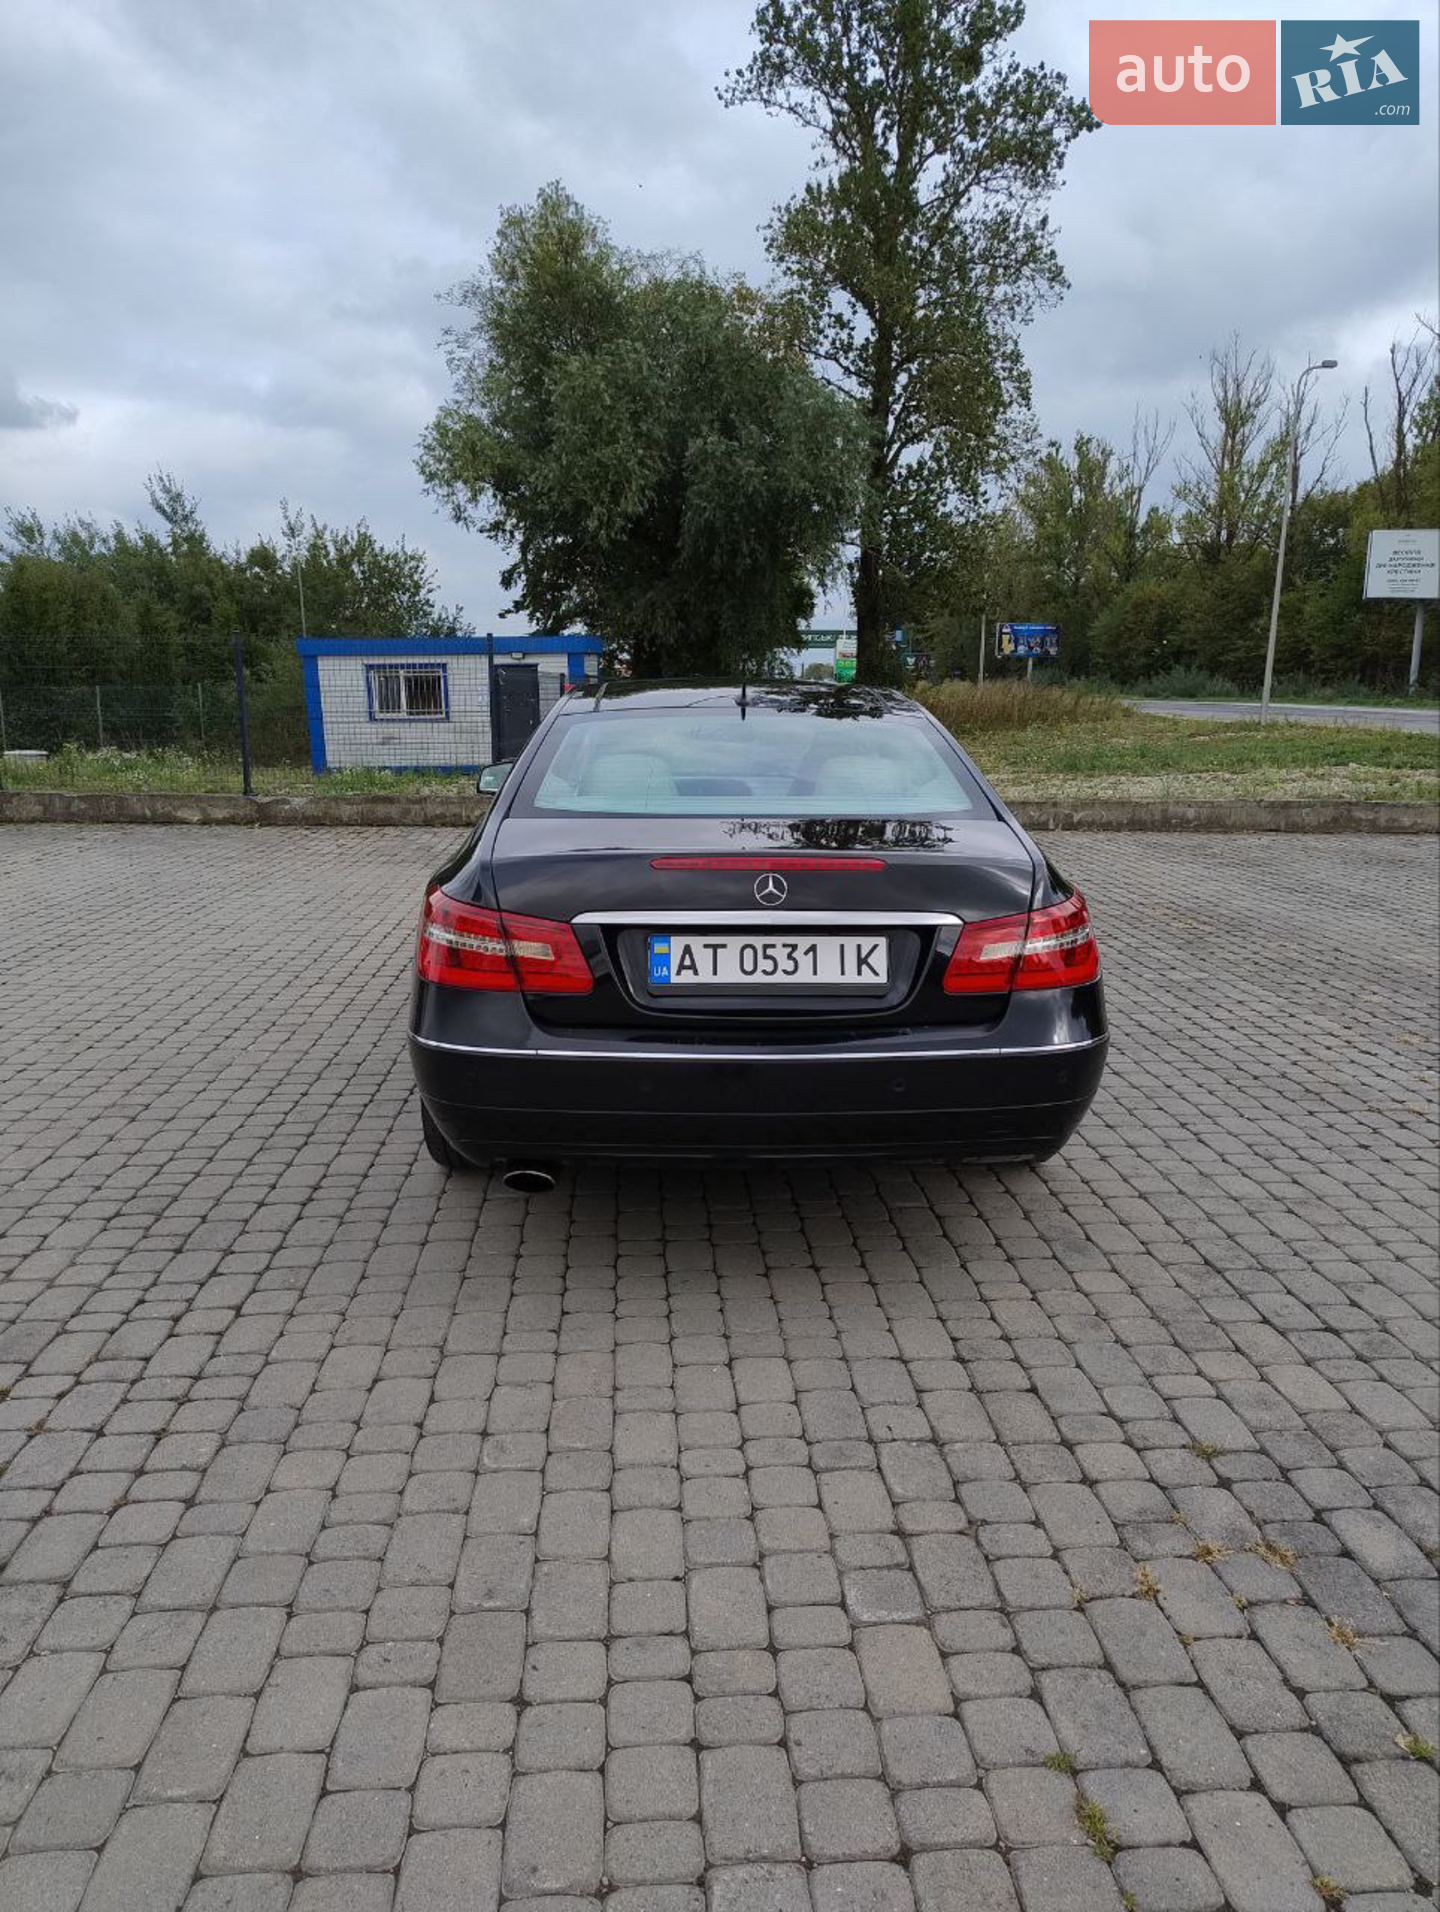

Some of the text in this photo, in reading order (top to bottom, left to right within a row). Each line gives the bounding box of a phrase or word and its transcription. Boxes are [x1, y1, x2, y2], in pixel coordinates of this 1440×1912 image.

[675, 943, 880, 976] AT 0531 IK
[653, 967, 669, 977] UA
